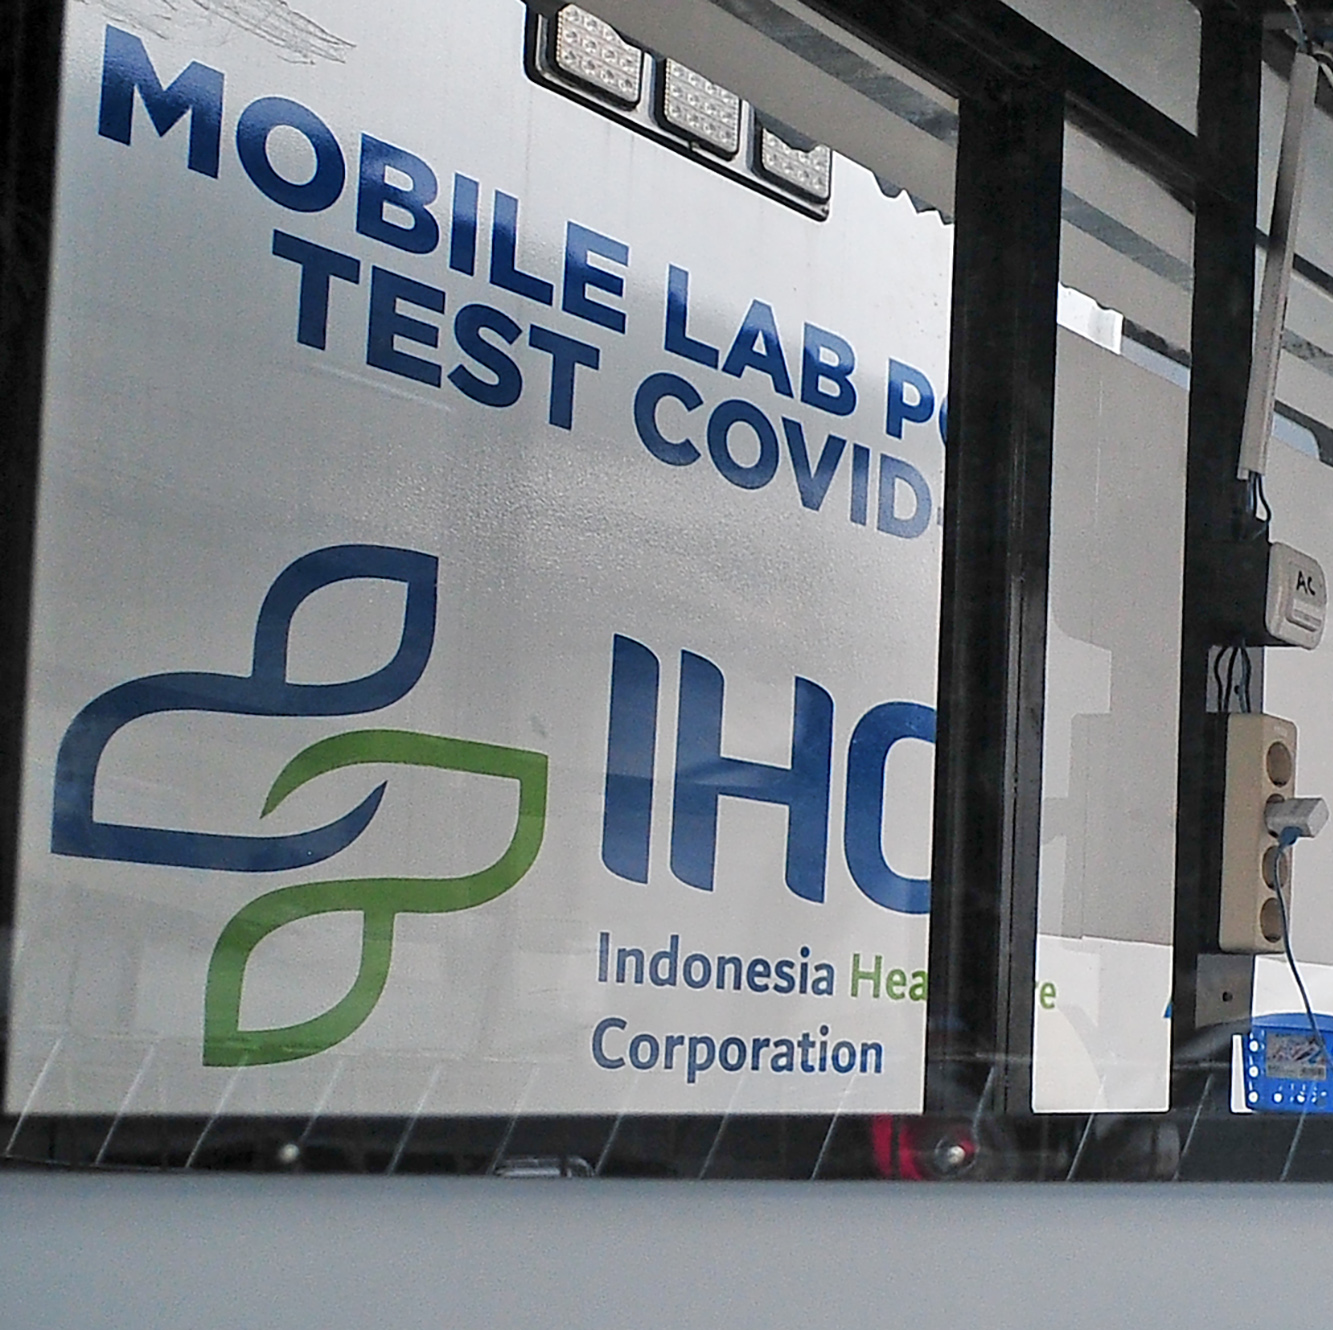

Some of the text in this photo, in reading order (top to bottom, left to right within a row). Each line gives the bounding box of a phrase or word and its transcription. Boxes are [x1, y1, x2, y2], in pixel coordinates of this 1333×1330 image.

[98, 24, 948, 448] MOBILE LAB P
[271, 229, 943, 540] TEST COVID
[1296, 570, 1316, 596] AC
[598, 932, 835, 996] Indonesia
[592, 1016, 883, 1084] Corporation
